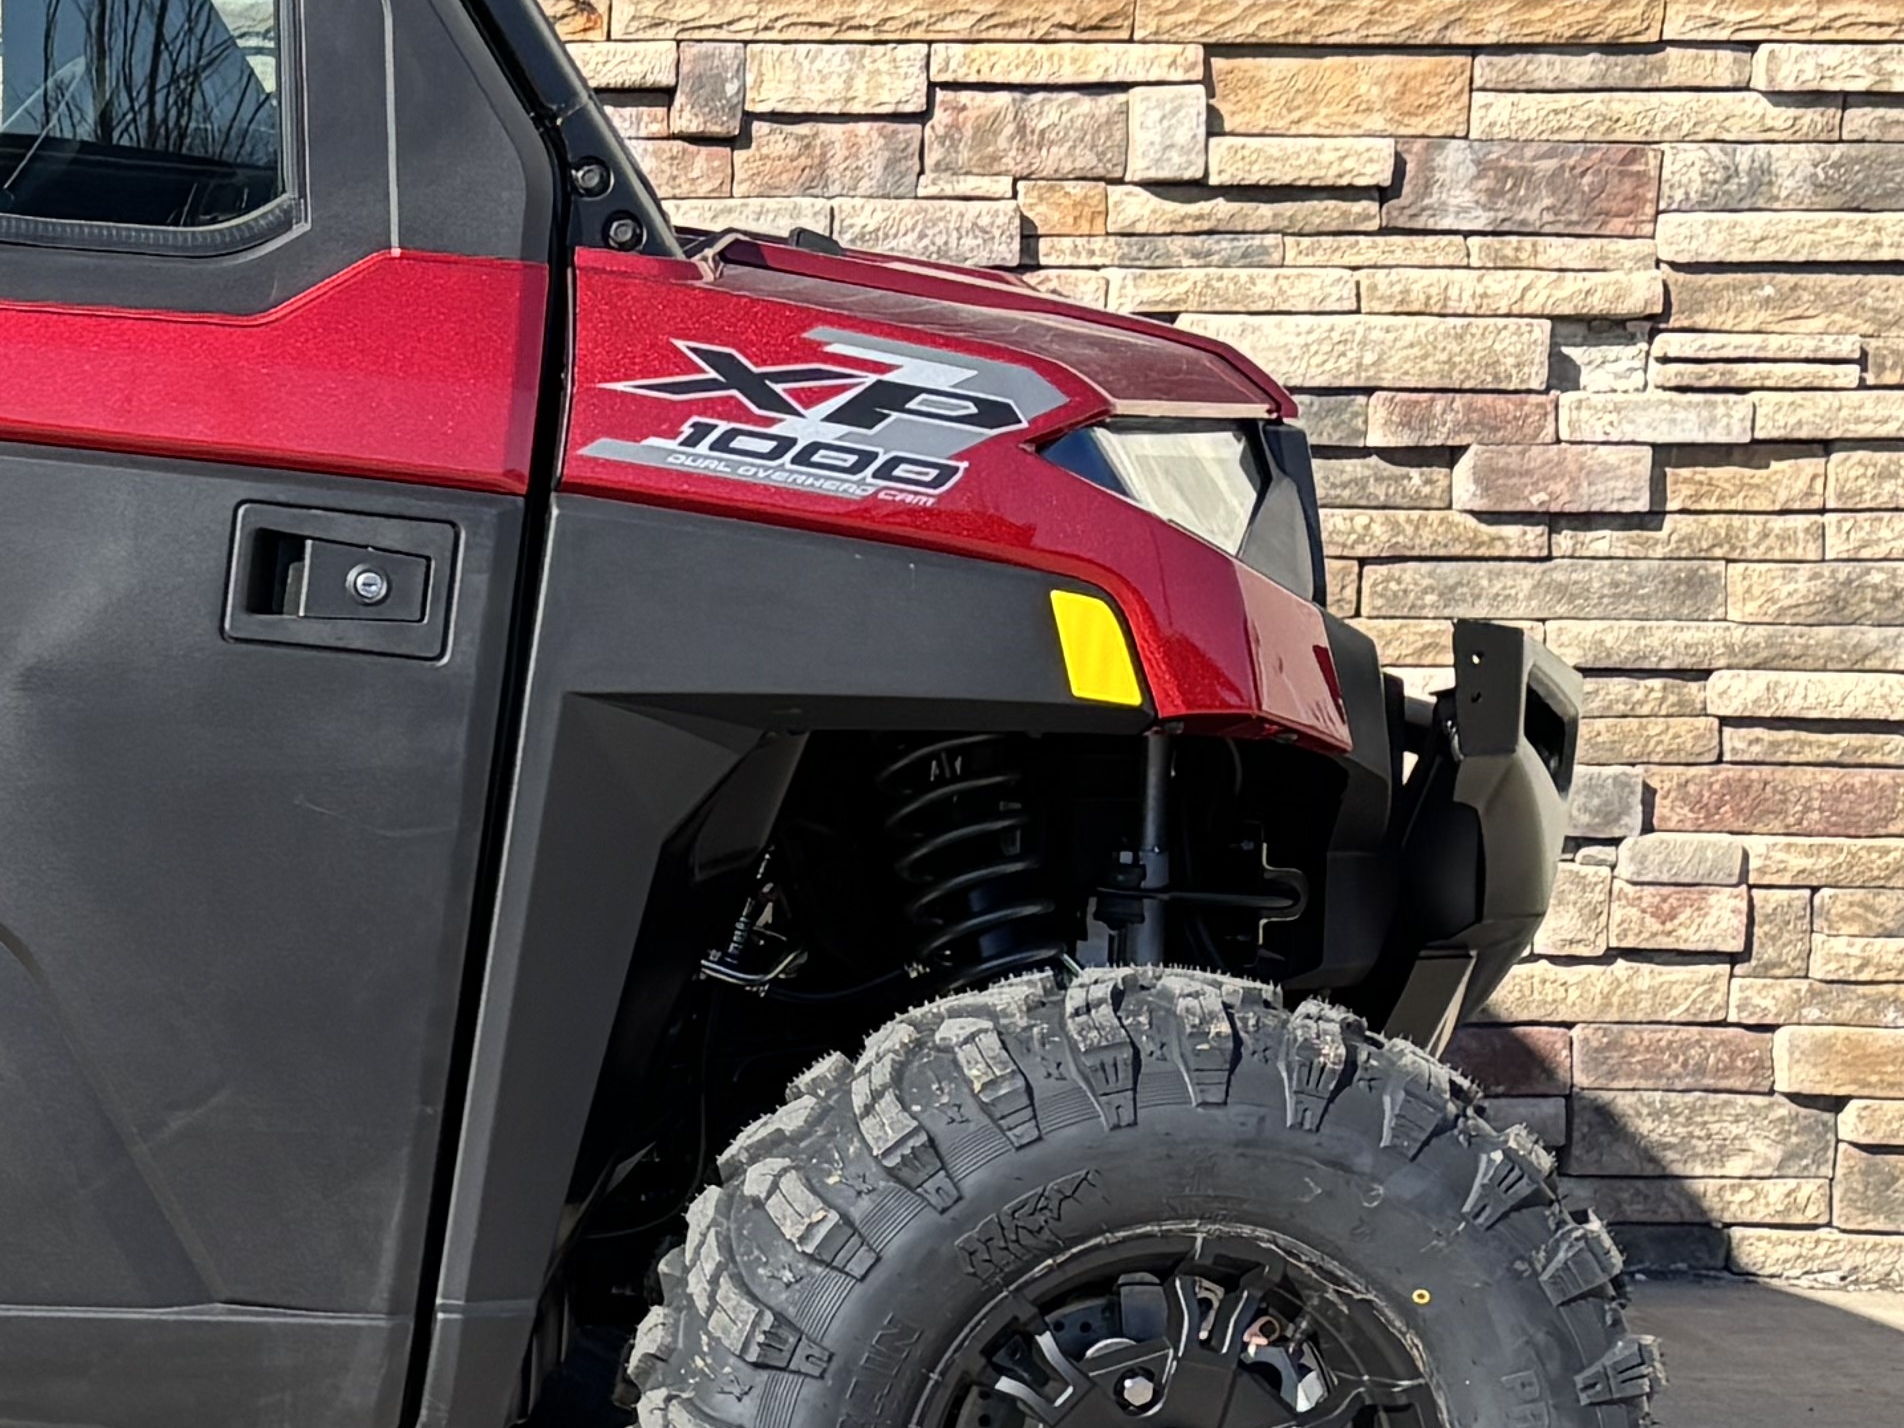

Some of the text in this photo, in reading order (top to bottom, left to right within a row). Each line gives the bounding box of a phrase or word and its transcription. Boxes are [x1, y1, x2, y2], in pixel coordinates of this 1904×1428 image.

[597, 338, 1029, 436] XP
[666, 452, 939, 508] DUAL OVERHEAD CAM
[676, 417, 966, 493] 1000
